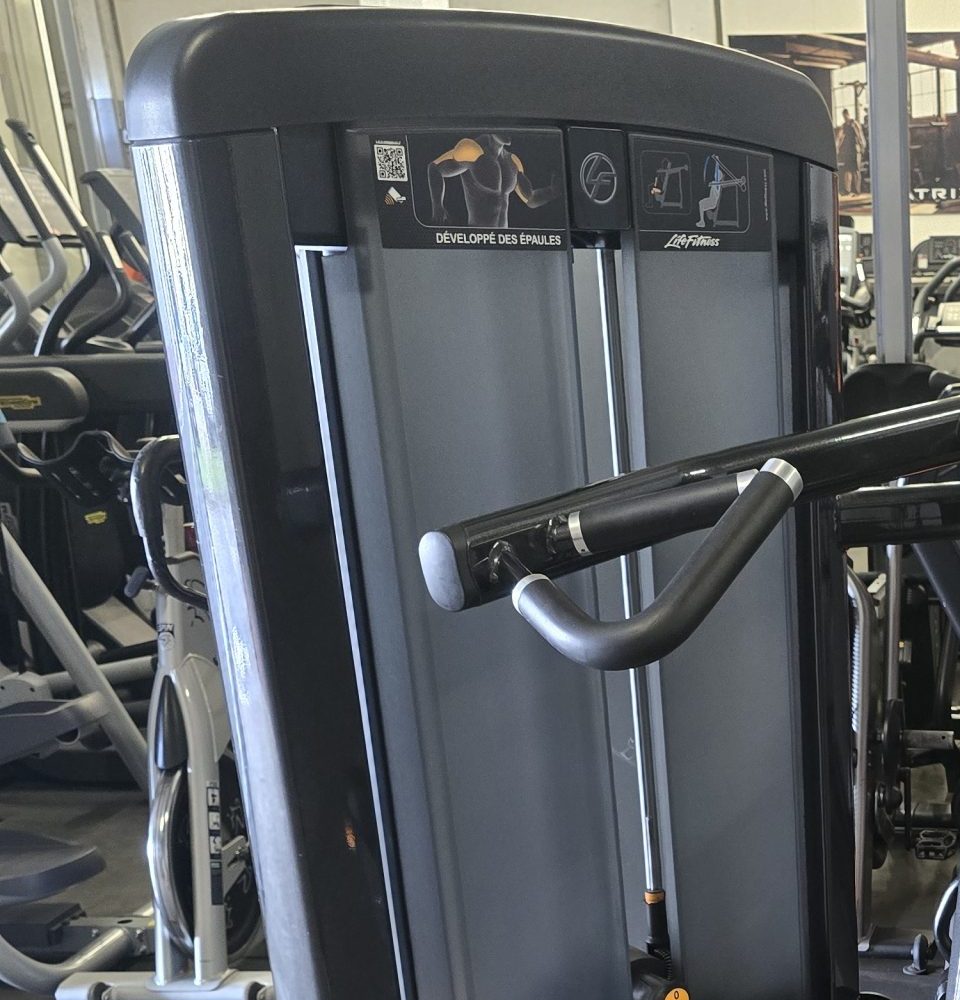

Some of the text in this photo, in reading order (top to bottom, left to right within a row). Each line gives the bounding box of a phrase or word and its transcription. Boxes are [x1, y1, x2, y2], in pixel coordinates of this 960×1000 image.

[435, 230, 561, 246] DÉVELOPPÉ DES ÉPAULES
[673, 990, 680, 1000] 0
